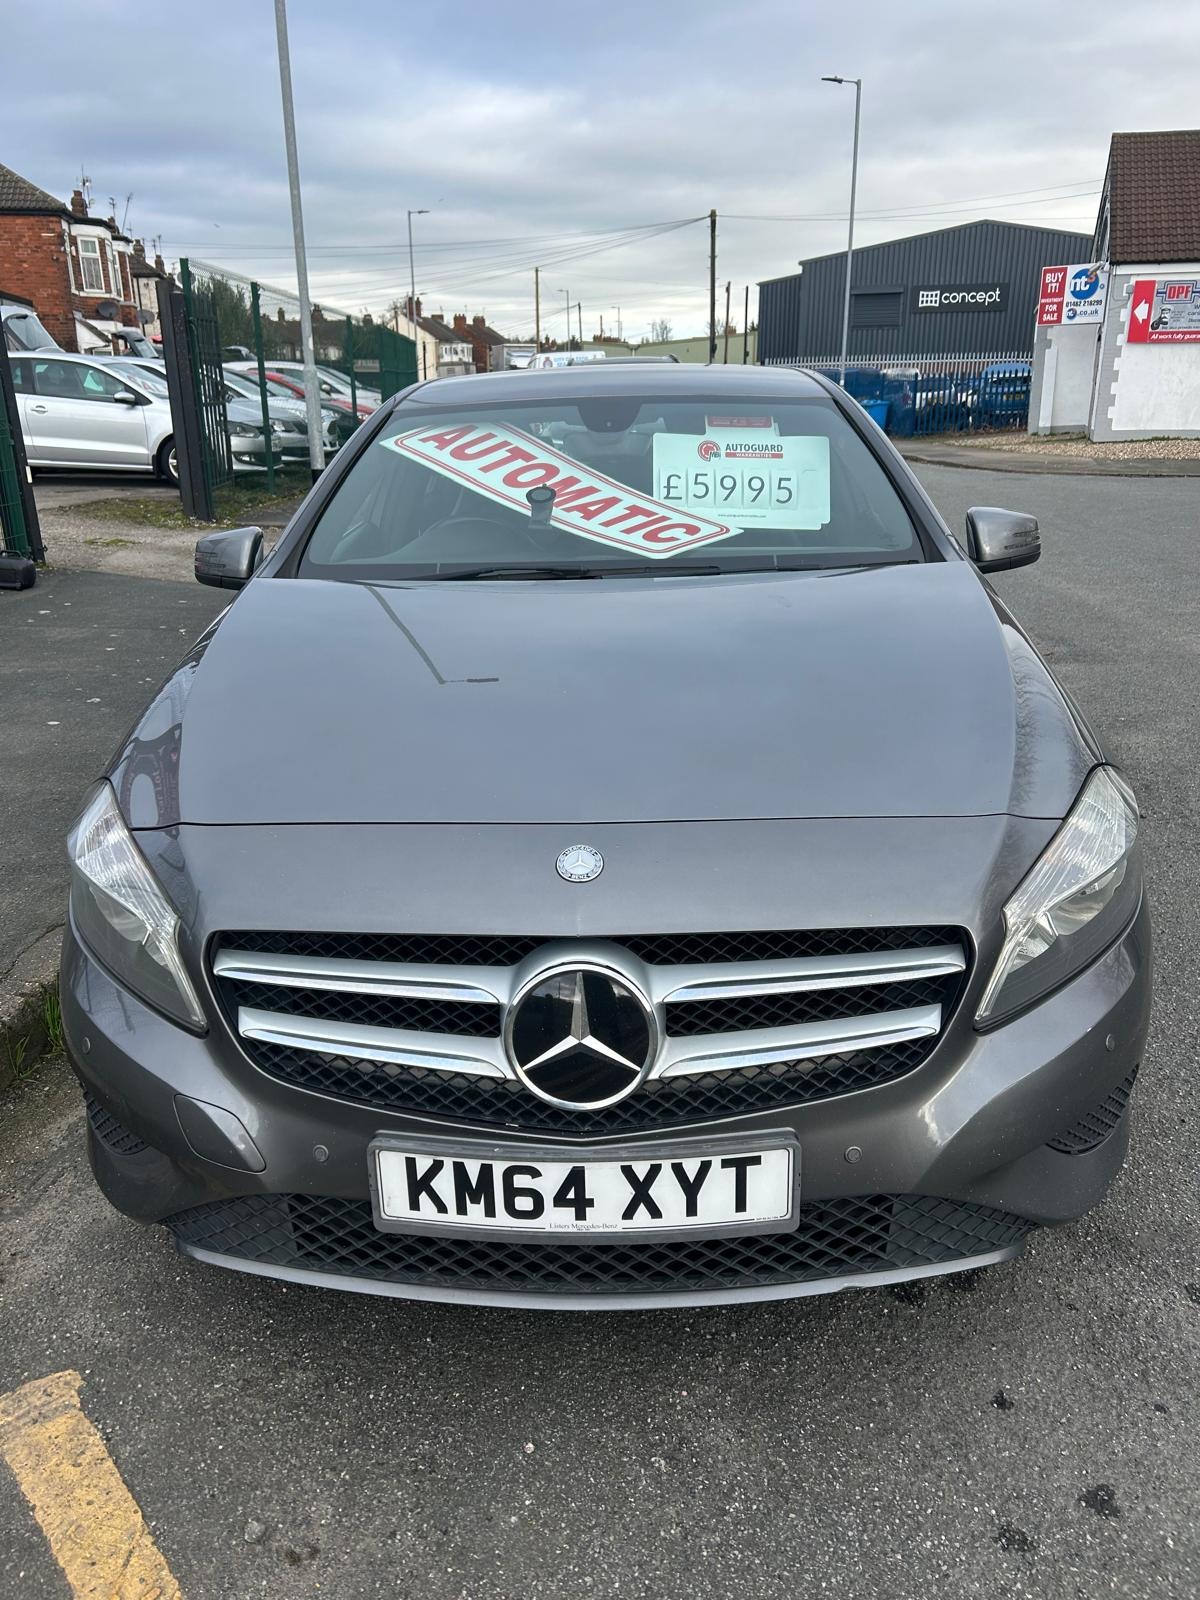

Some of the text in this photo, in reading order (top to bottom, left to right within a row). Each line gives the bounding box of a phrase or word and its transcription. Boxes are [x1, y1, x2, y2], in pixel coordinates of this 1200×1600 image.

[1045, 272, 1064, 283] BUY
[1047, 283, 1059, 293] IT!
[941, 288, 1000, 306] concept
[1045, 304, 1058, 312] FOR
[1043, 313, 1058, 322] SALE
[725, 443, 783, 452] AUTOGUARD
[418, 424, 702, 544] AUTOMATIC
[663, 473, 793, 504] £5995
[405, 1155, 762, 1221] KM64 XYT
